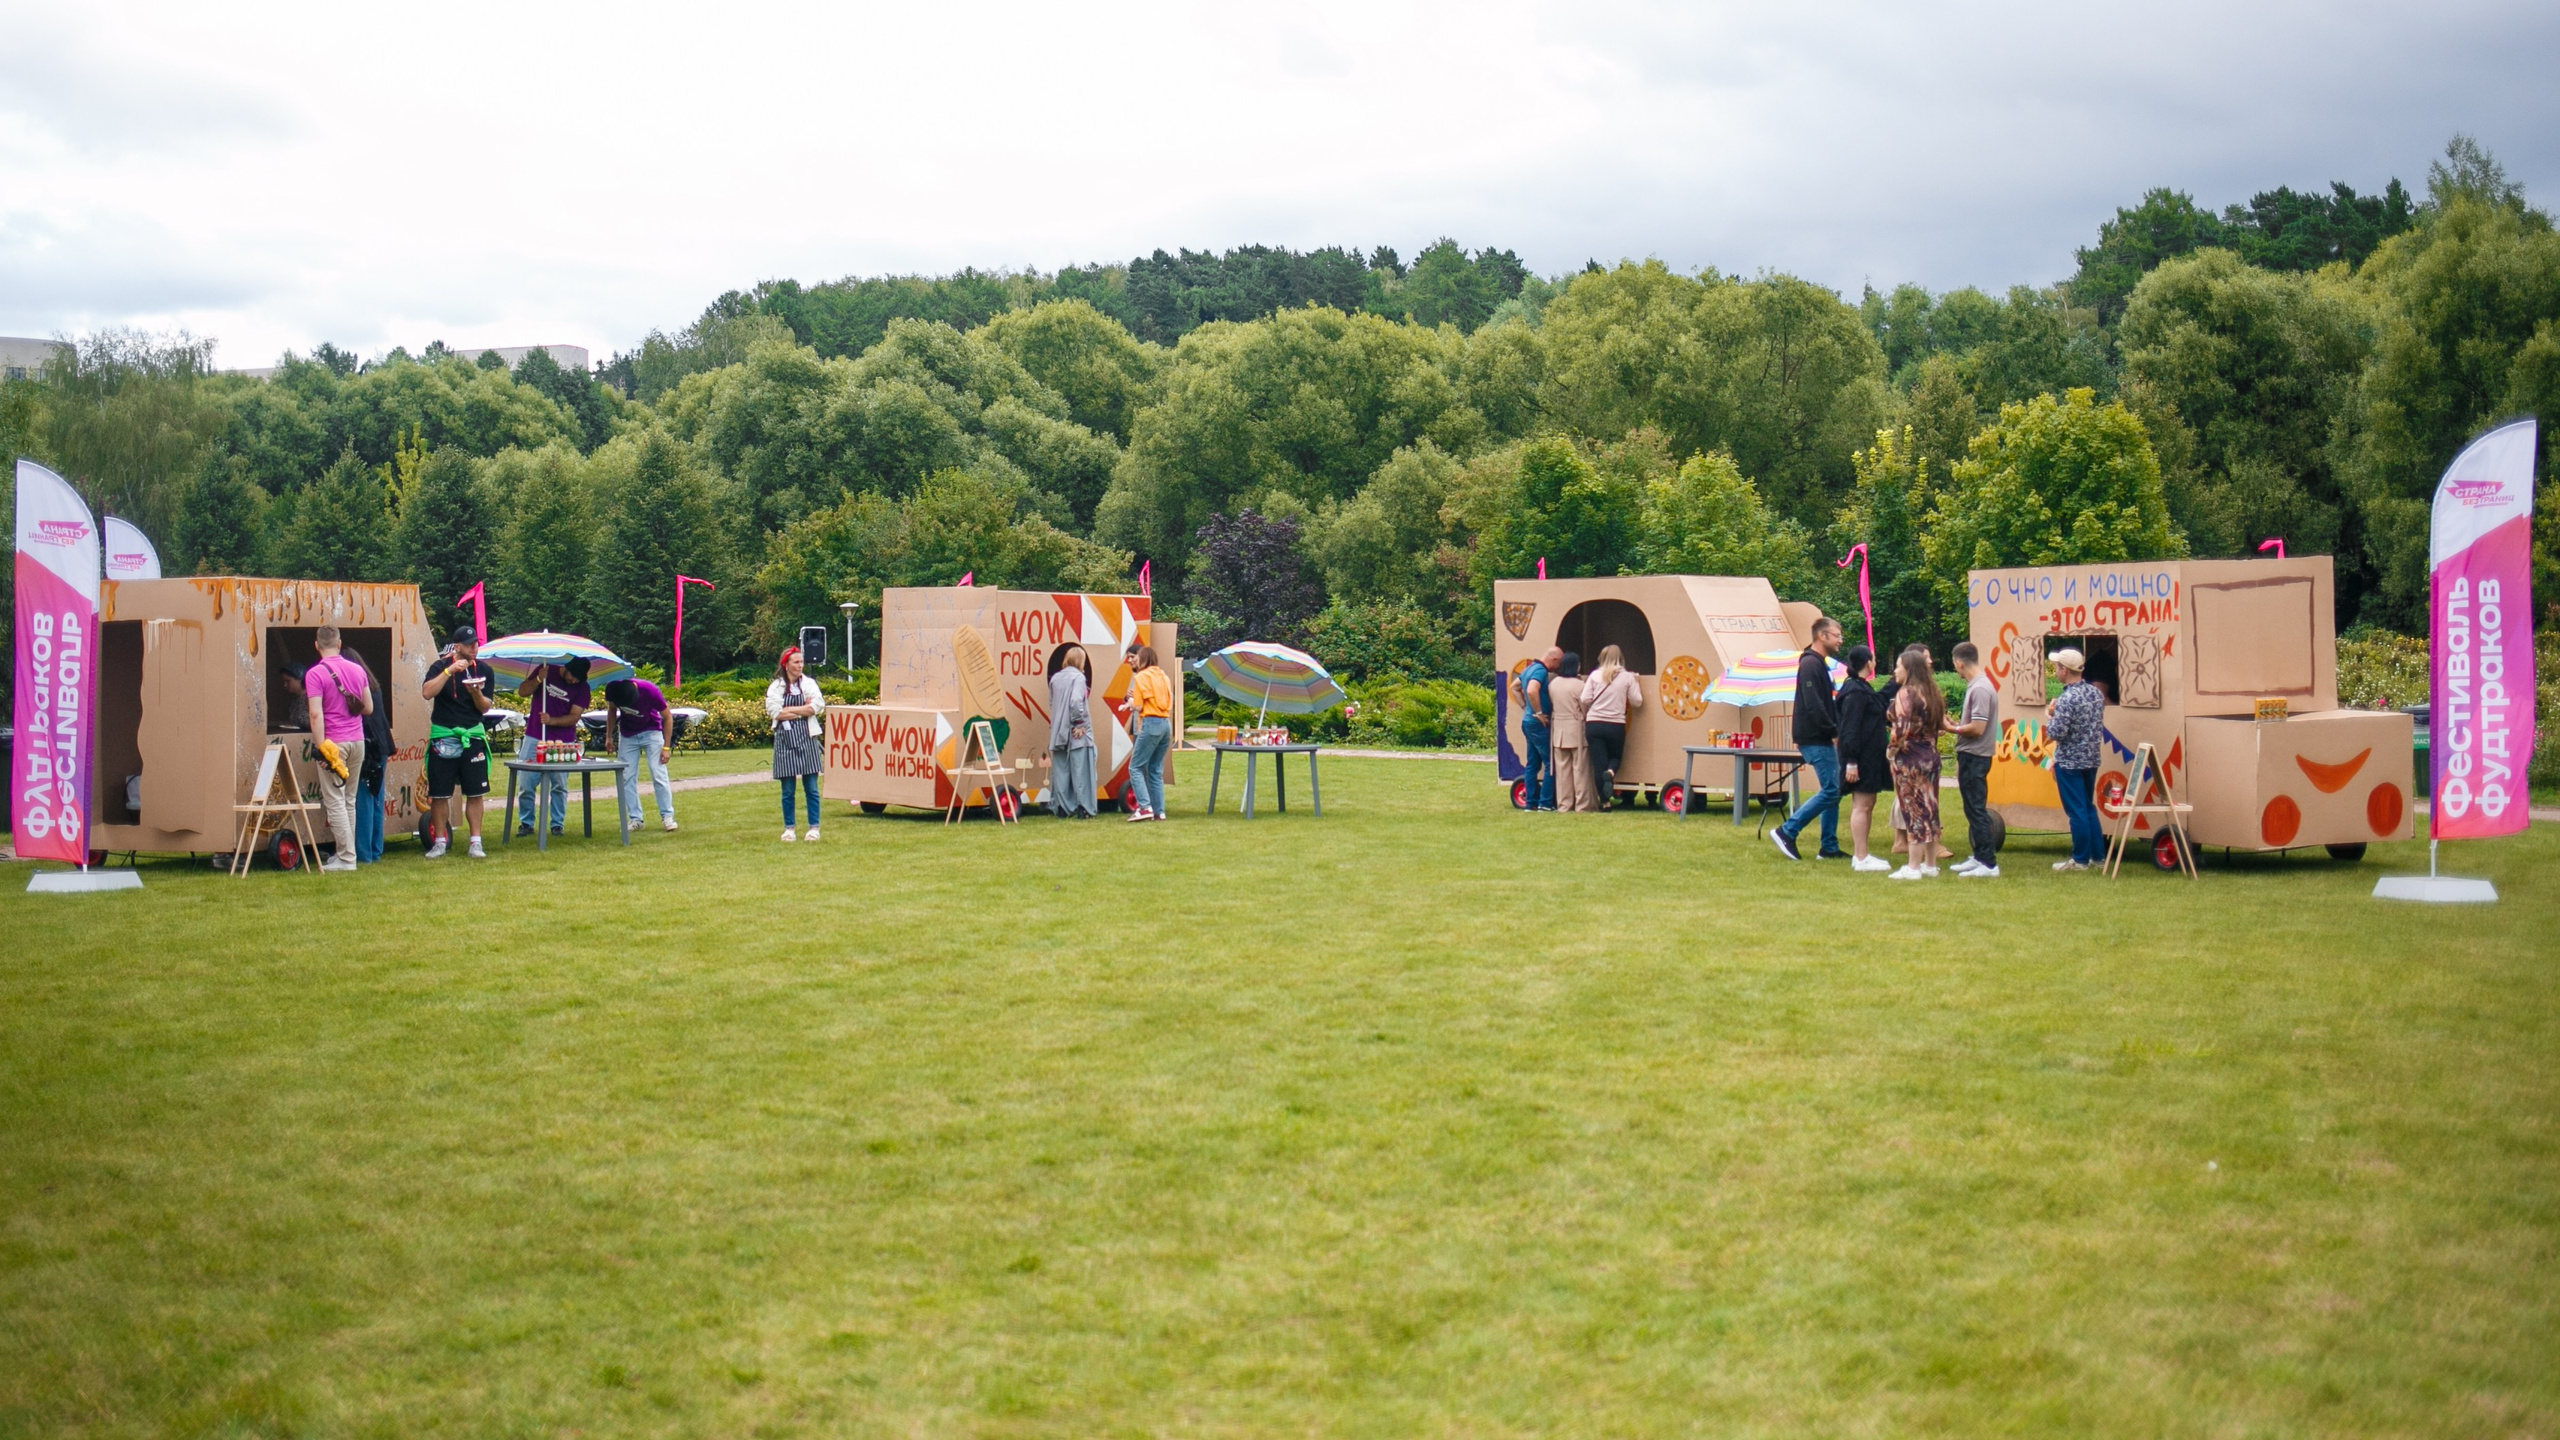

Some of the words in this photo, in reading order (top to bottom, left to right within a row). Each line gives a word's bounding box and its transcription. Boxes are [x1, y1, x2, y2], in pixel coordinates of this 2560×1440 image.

[2454, 485, 2496, 497] СТРАНА
[2462, 498, 2479, 506] БЕЗ
[2480, 494, 2515, 503] ГРАНИЦ
[1967, 576, 2052, 608] СОЧНО
[2064, 577, 2077, 602] И
[2089, 573, 2171, 599] МОЩНО
[2093, 581, 2180, 626] СТРАНА!
[1000, 609, 1067, 644] WOW
[1709, 617, 1758, 631] СТРАНА
[1000, 645, 1043, 676] rolls
[2441, 577, 2472, 818] Фестиваль
[2474, 578, 2511, 817] фудтраков
[830, 712, 890, 744] WOW
[890, 726, 936, 756] WOW
[830, 741, 874, 771] rolls
[885, 754, 934, 780] ЖИЗНЬ
